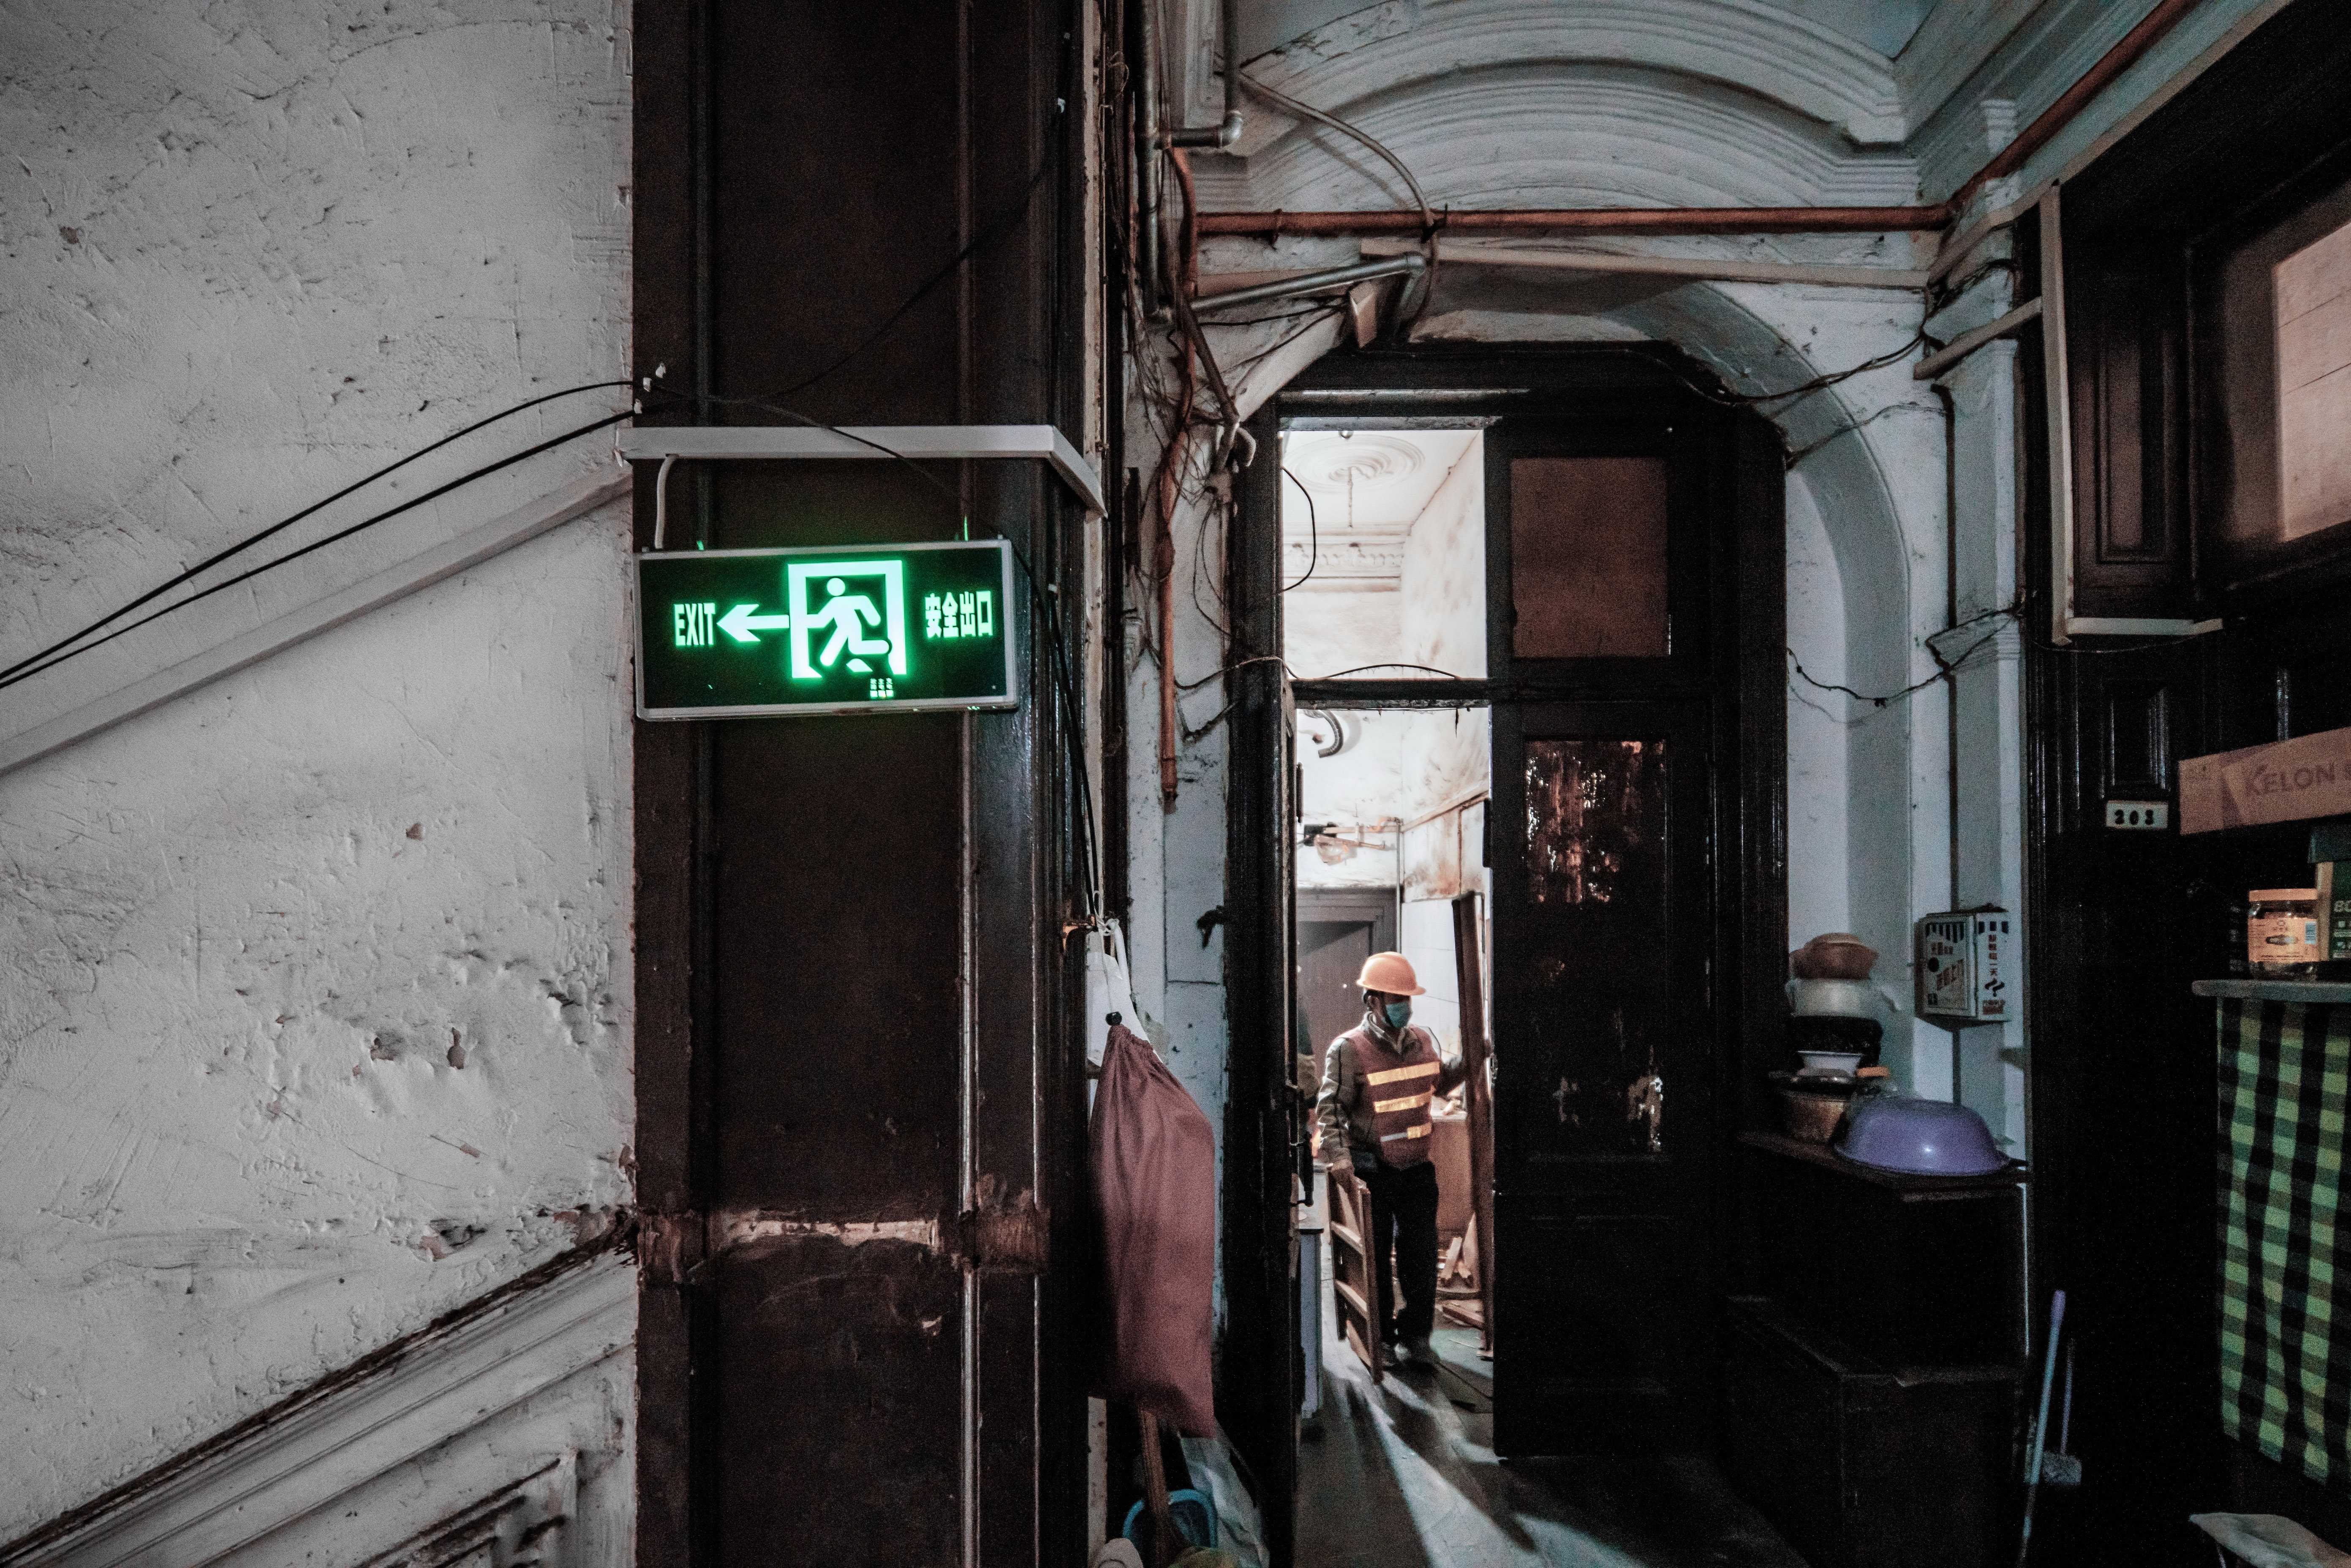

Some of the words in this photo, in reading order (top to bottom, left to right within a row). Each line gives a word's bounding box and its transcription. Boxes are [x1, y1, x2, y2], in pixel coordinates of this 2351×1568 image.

[674, 602, 716, 646] EXIT
[925, 590, 993, 639] 安全出口
[2245, 762, 2335, 797] KELON
